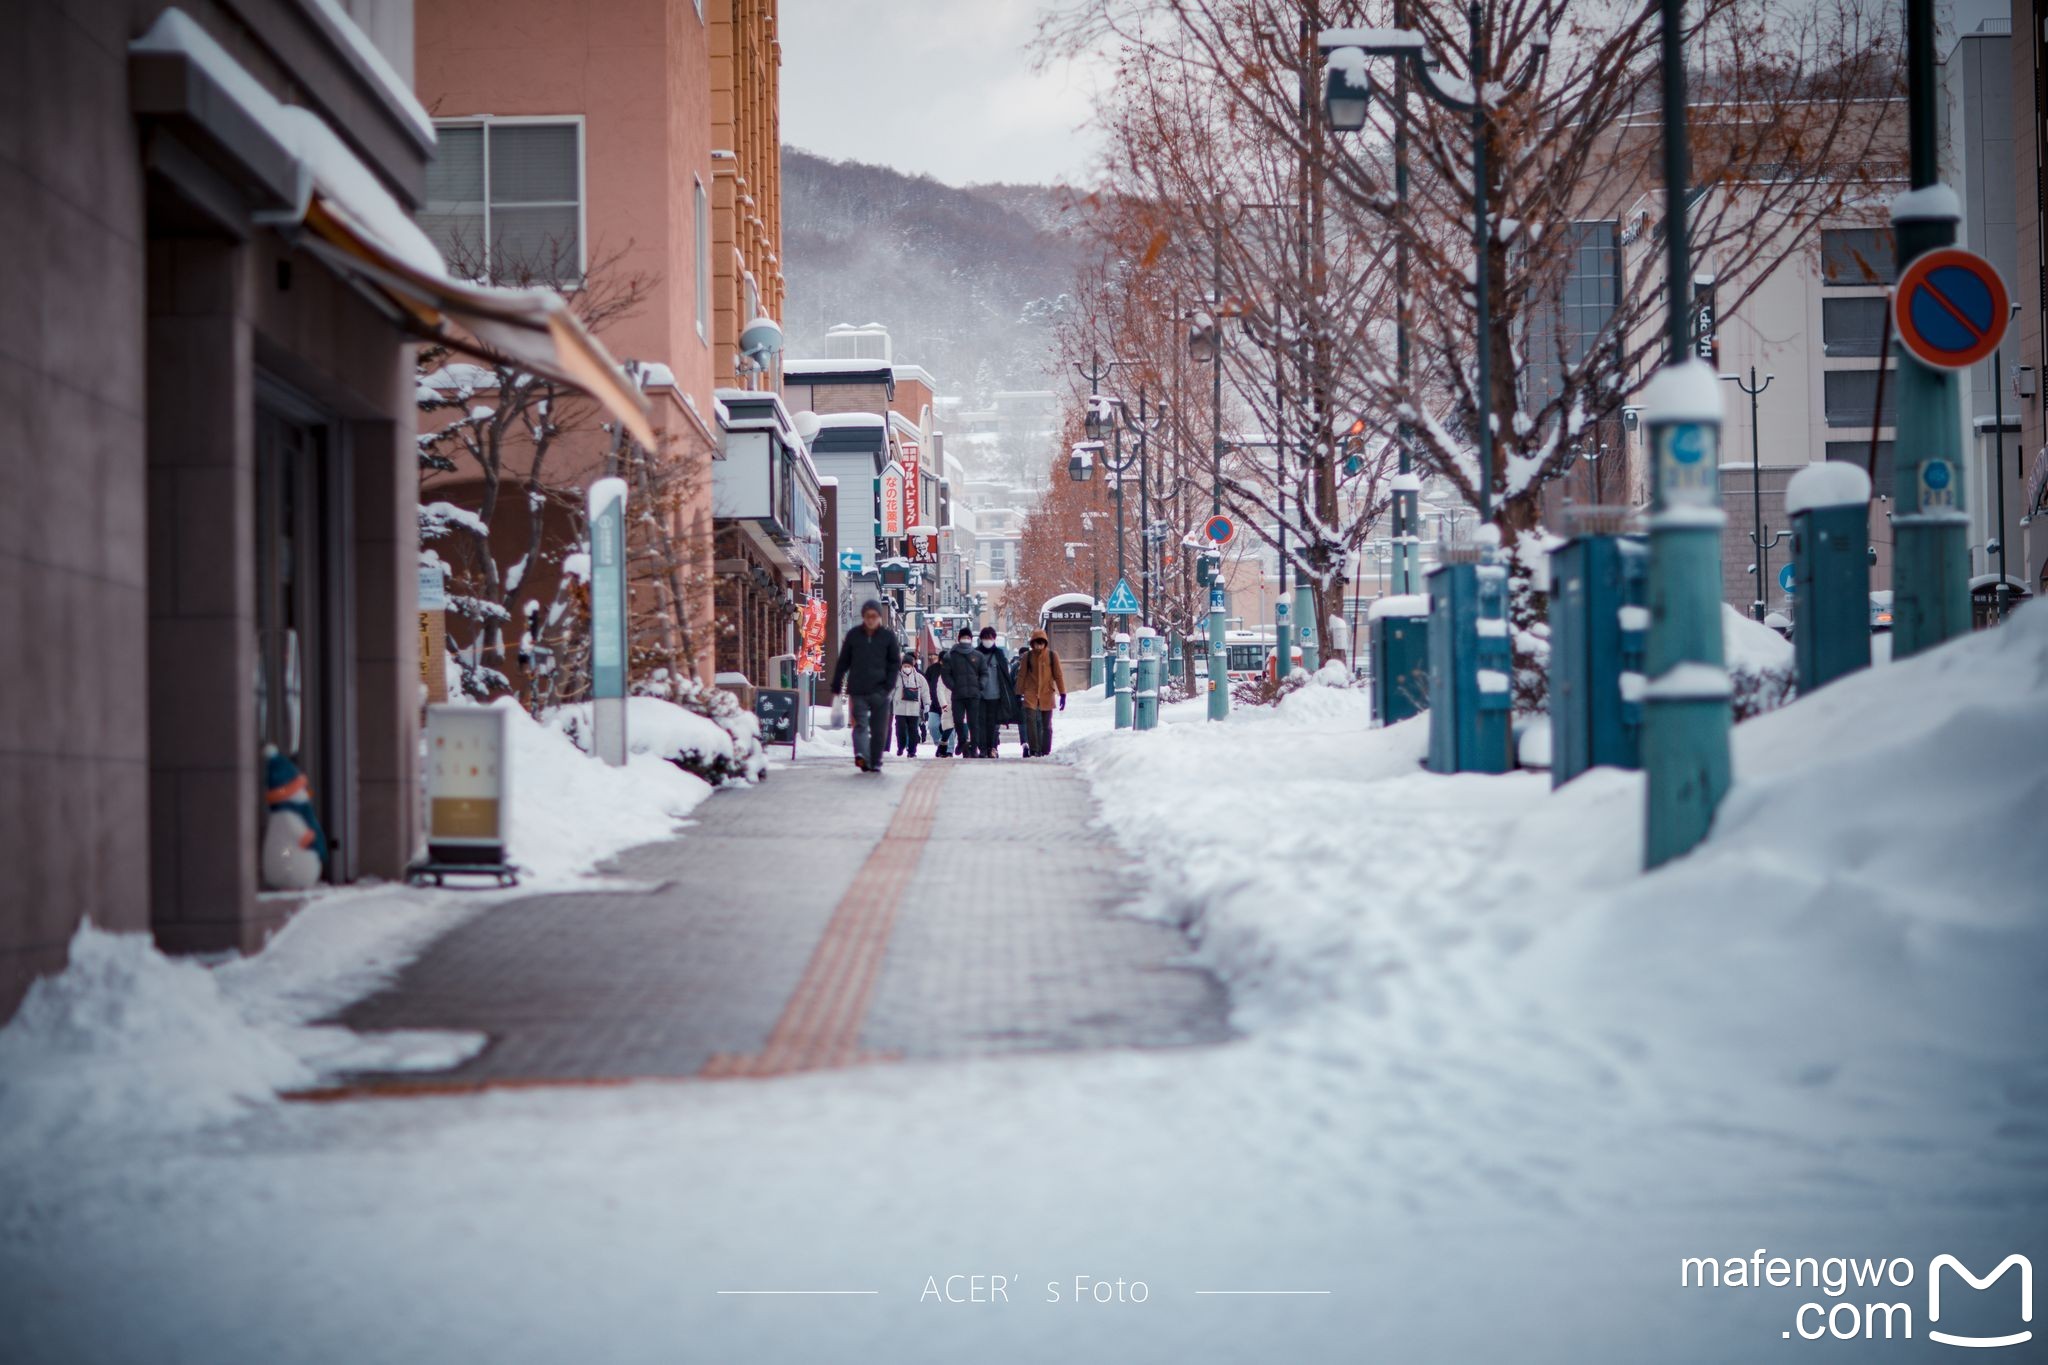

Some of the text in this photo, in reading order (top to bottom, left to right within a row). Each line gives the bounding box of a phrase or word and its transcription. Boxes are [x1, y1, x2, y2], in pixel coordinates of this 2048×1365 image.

[1700, 305, 1712, 357] HAPPY
[885, 477, 898, 533] なの花薬局
[904, 462, 916, 525] ツルハドラッグ
